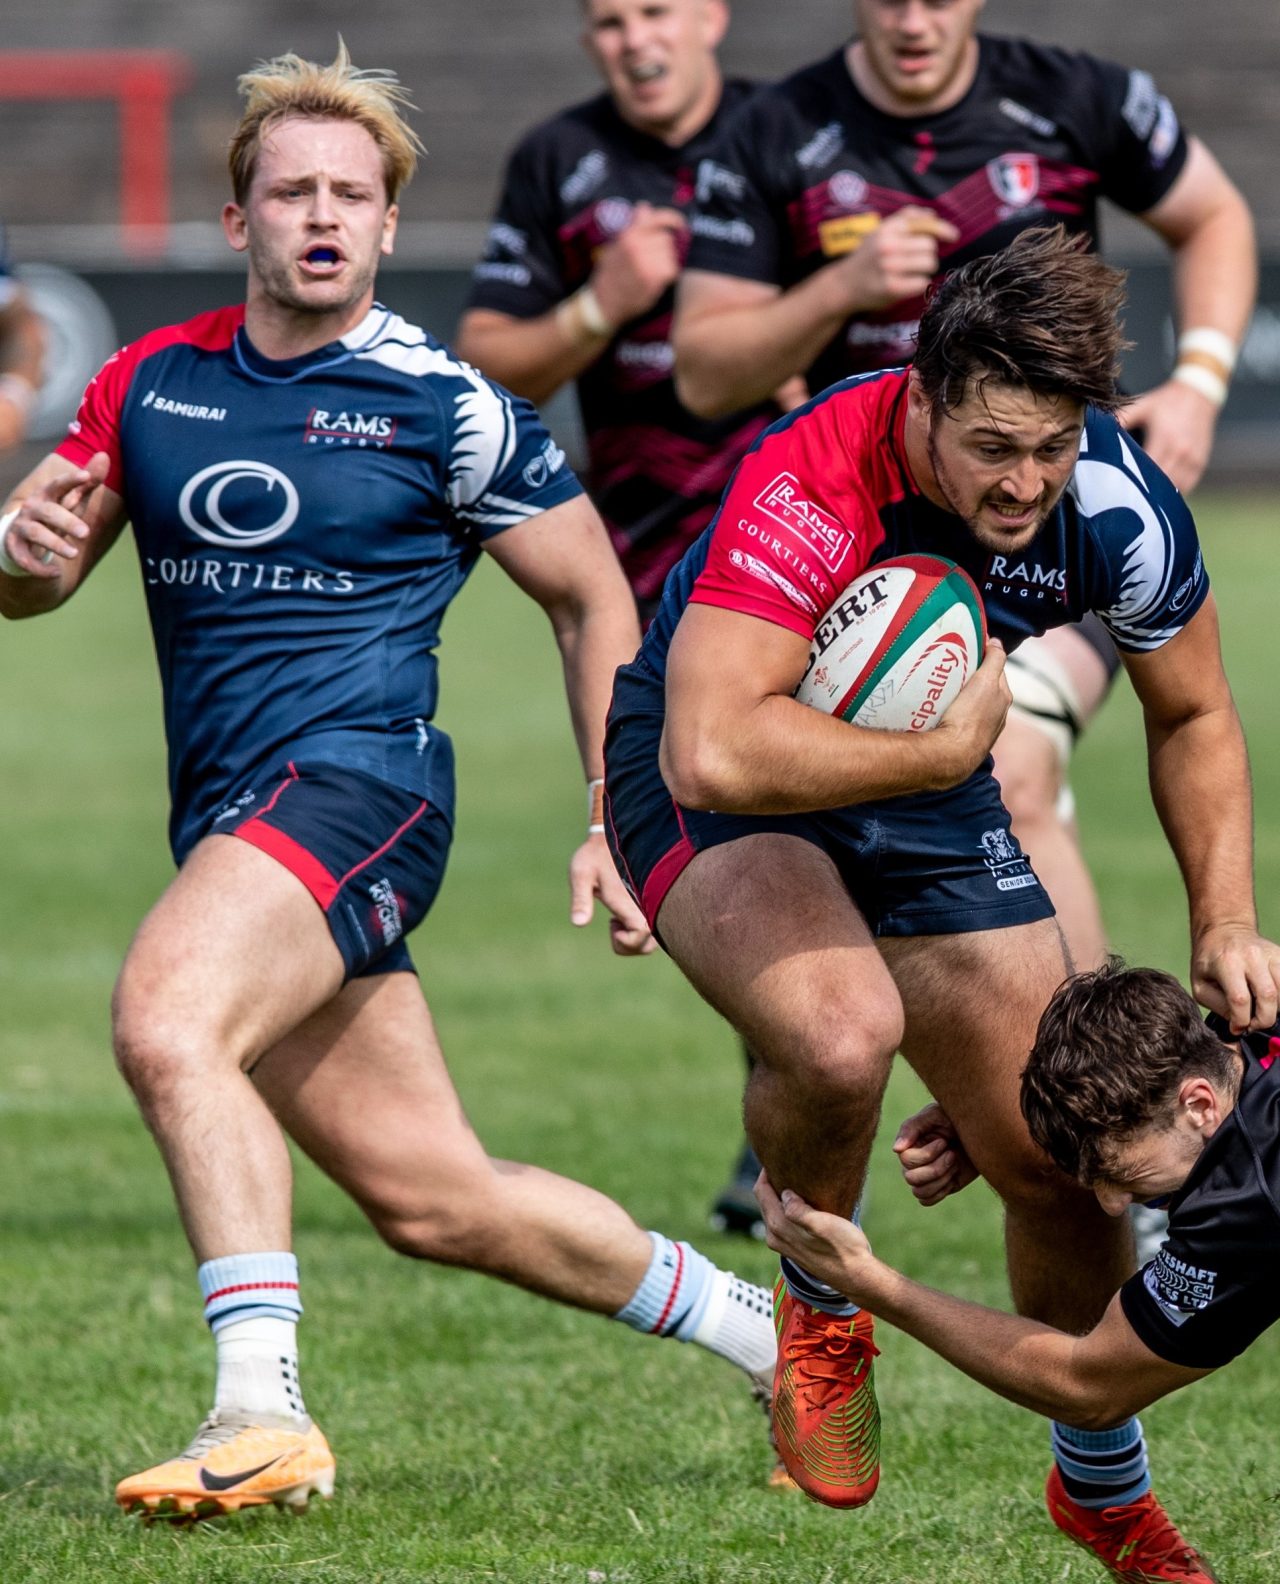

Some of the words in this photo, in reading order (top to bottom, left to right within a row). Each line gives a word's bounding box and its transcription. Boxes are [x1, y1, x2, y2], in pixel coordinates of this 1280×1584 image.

[153, 397, 227, 421] SAMURAI
[312, 409, 392, 437] RAMS
[308, 435, 385, 449] RUGBY
[738, 519, 828, 593] COURTIERS
[990, 555, 1066, 590] RAMS
[985, 582, 1062, 603] RUGBY
[1183, 1295, 1208, 1309] LTD
